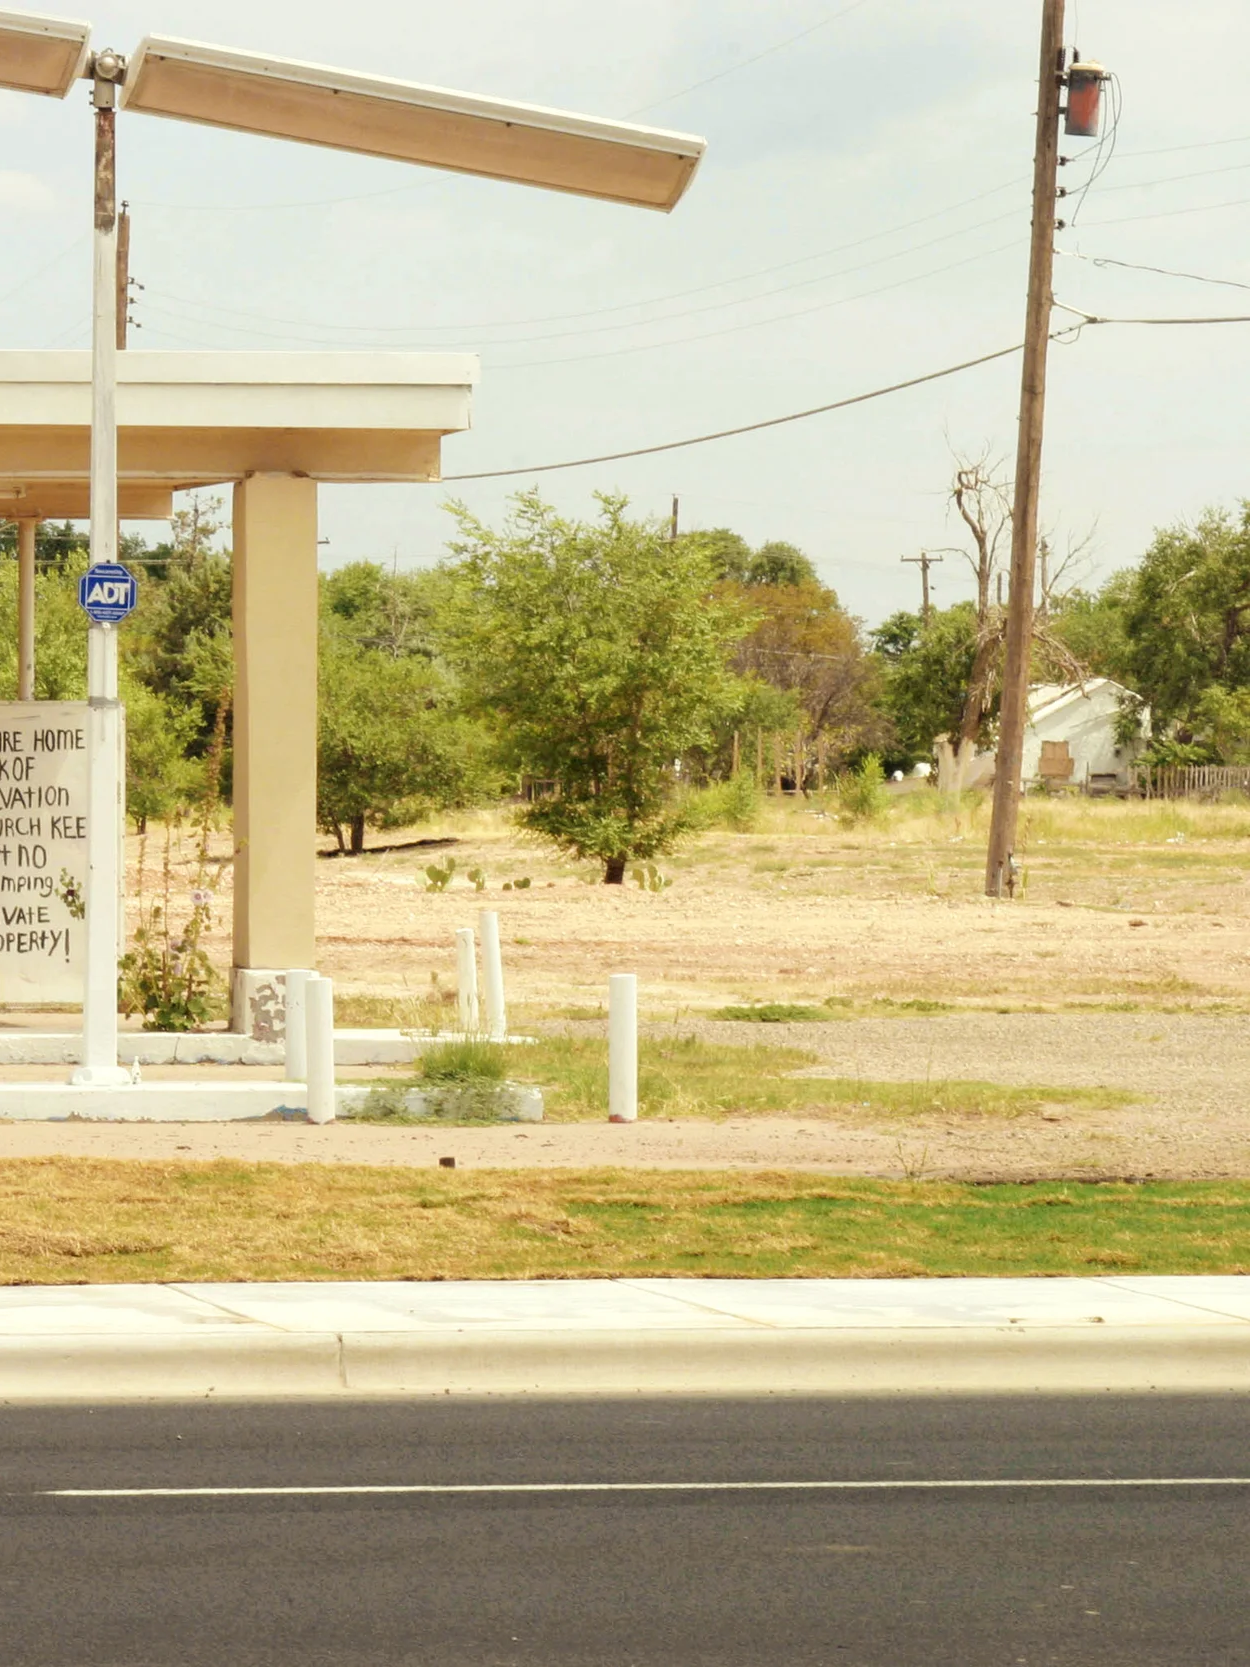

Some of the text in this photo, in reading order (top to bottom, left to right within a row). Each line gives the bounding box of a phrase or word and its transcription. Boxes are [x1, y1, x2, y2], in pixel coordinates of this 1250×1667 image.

[87, 581, 130, 605] ADT
[12, 756, 36, 782] OF
[50, 816, 87, 840] KEE
